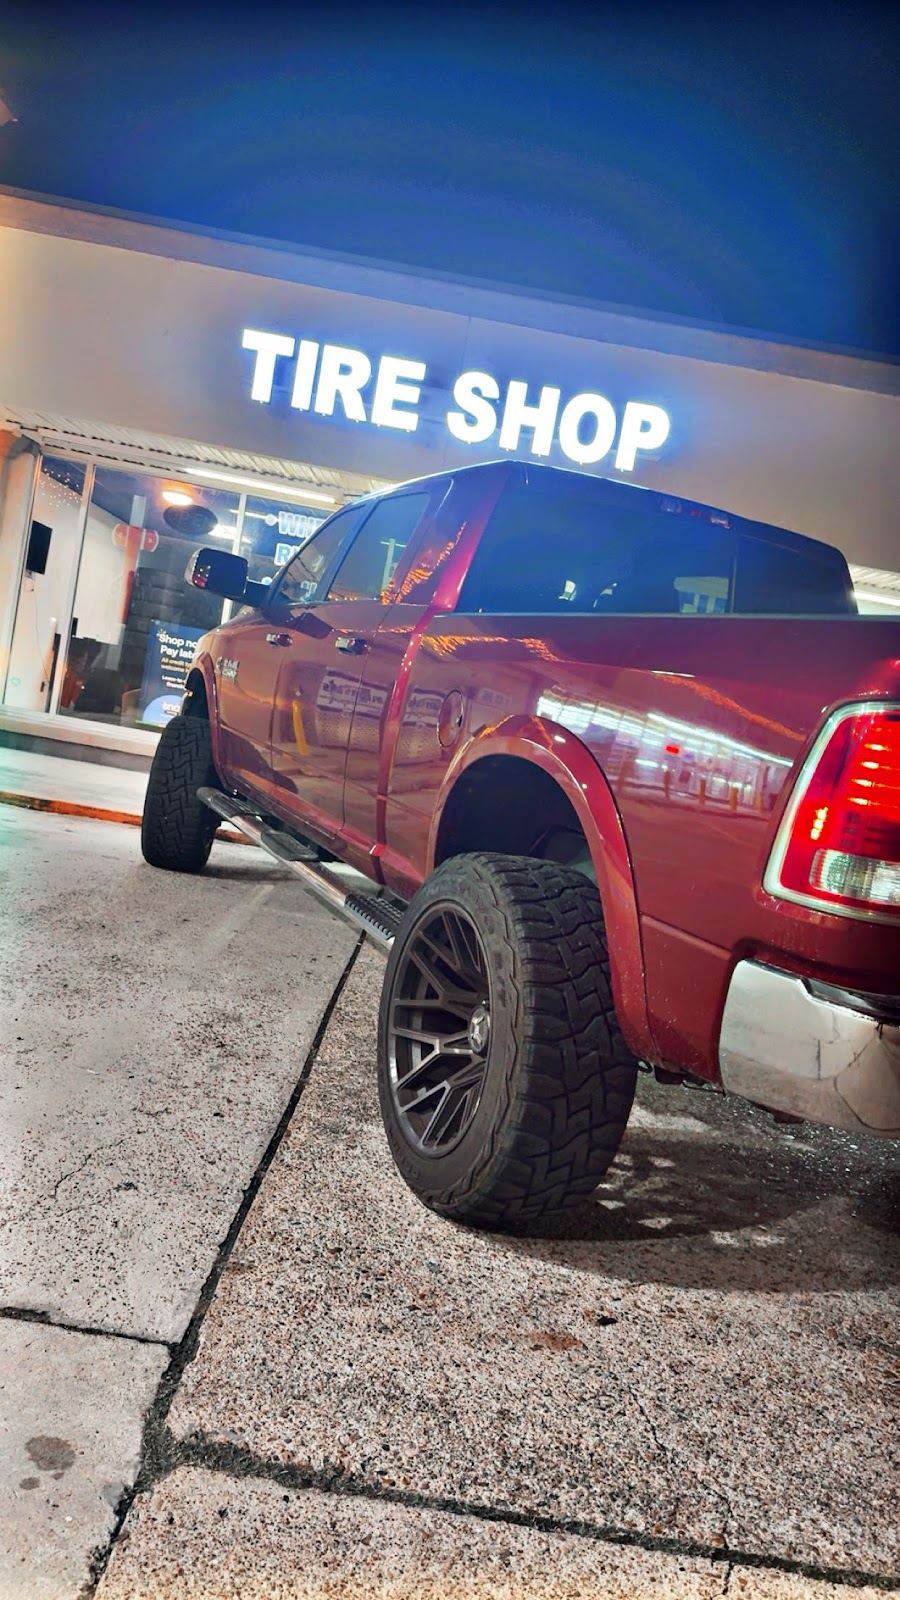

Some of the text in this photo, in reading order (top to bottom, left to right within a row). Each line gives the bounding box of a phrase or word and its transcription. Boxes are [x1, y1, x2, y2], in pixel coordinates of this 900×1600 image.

[241, 328, 670, 471] TIRE SHOP
[159, 633, 185, 647] Shop
[160, 645, 179, 658] Pay
